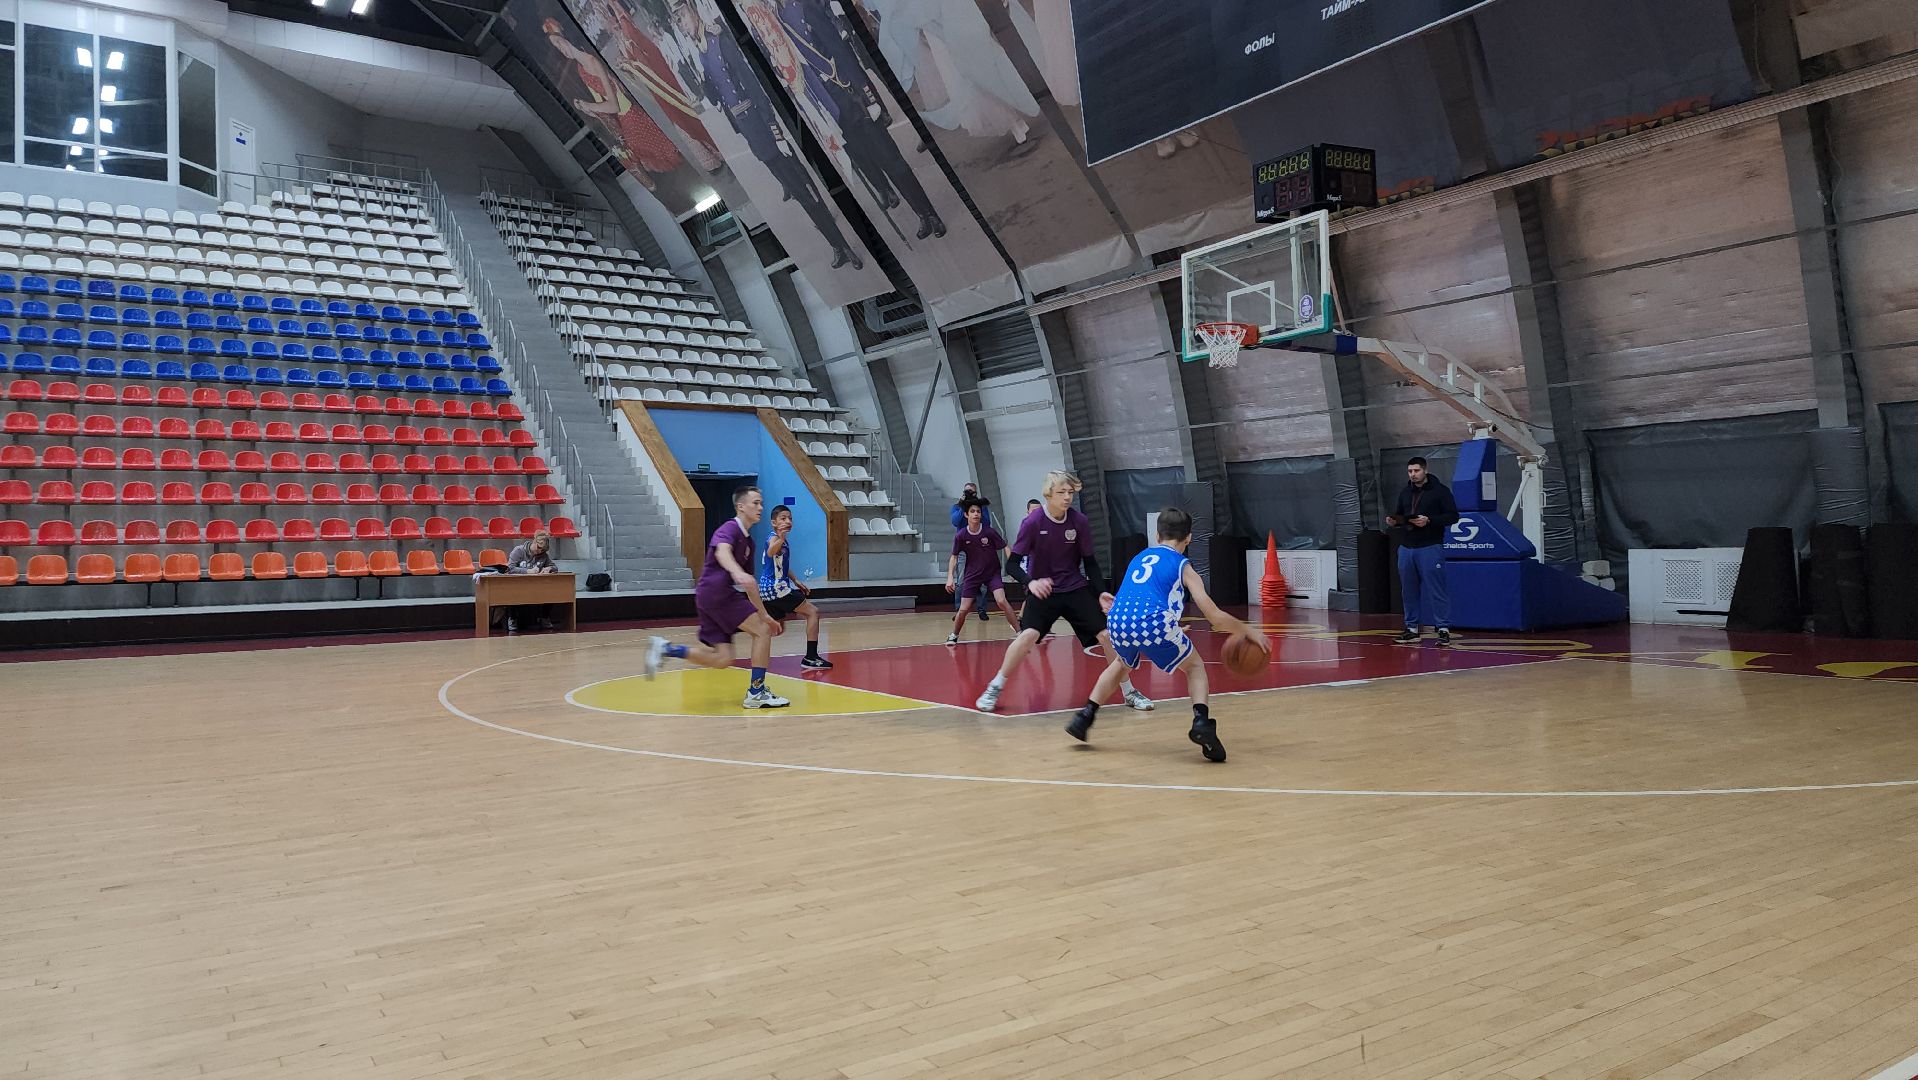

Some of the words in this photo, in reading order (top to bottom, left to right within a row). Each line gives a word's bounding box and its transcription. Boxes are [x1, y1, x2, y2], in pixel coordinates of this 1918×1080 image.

[1321, 0, 1366, 20] ТАЙМ-
[1244, 32, 1275, 55] ФОЛЫ
[1131, 554, 1160, 584] 3
